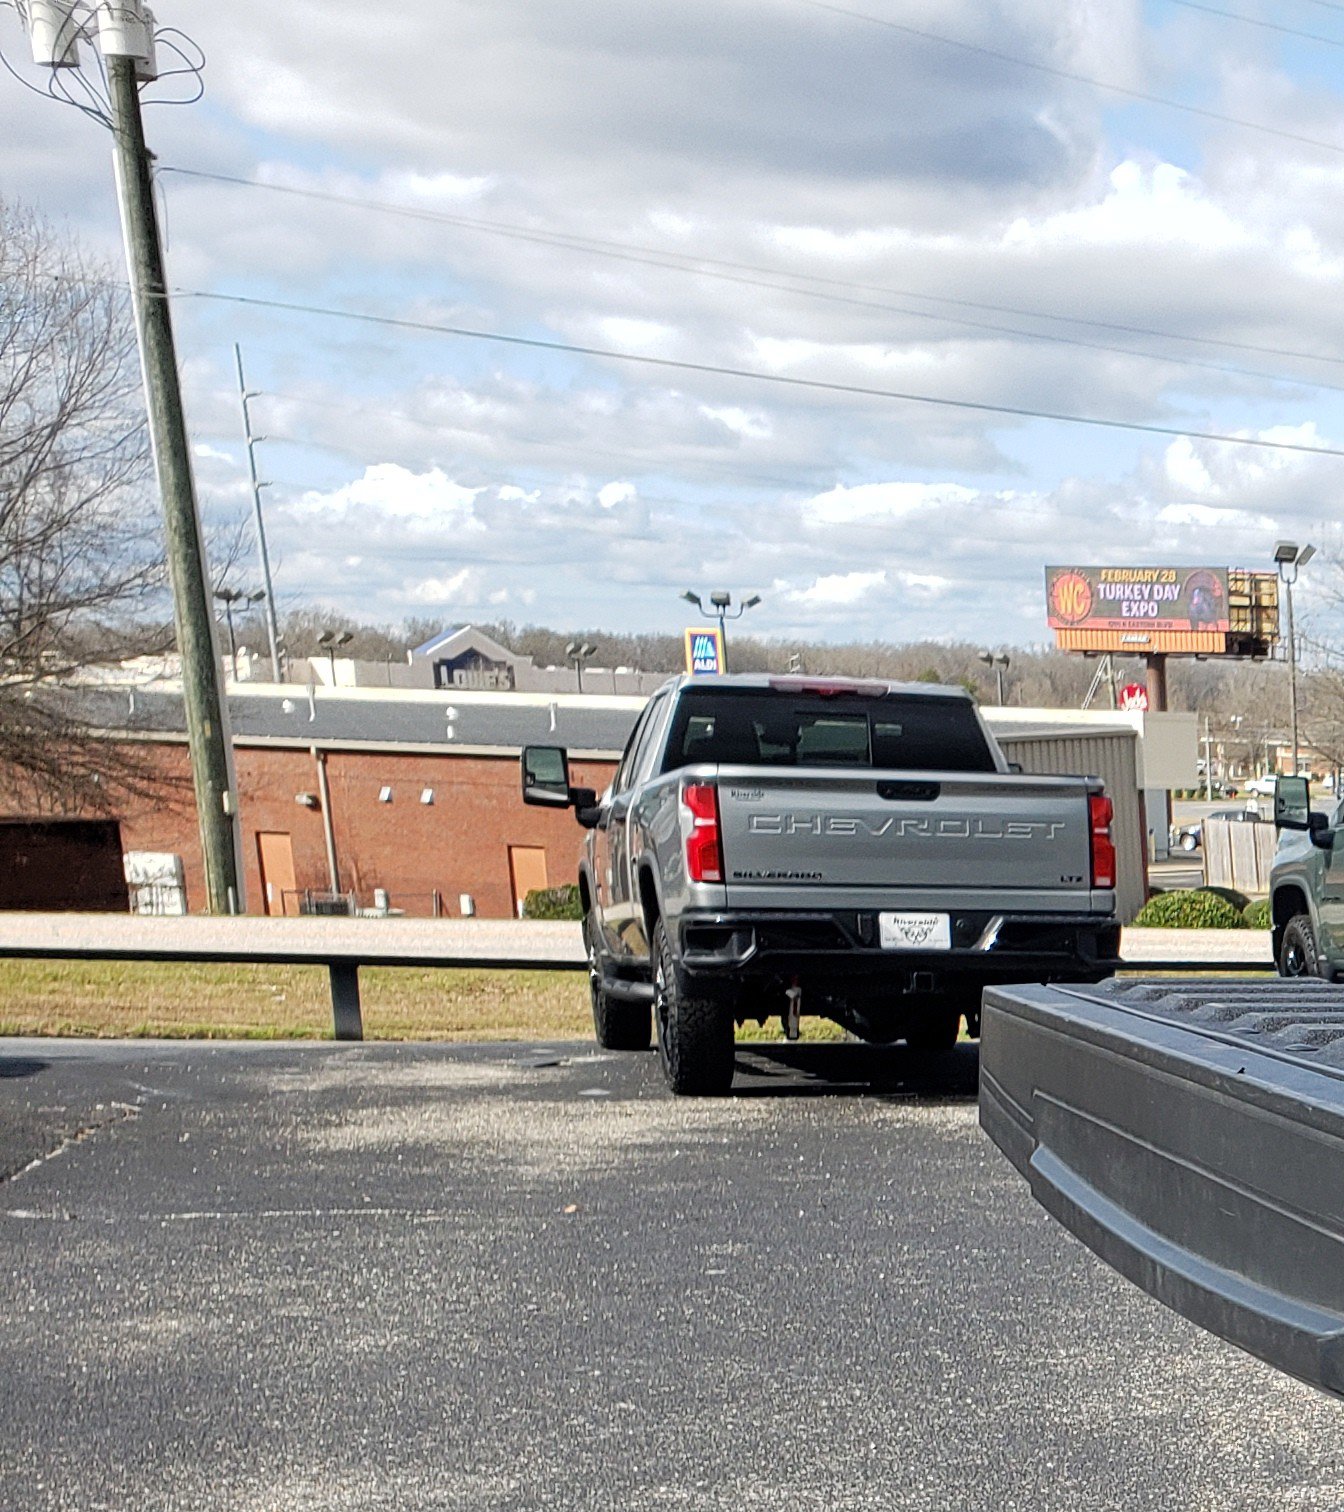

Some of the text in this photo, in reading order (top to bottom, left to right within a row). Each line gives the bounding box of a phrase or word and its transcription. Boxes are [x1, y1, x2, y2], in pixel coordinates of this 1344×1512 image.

[1101, 569, 1159, 582] FEBRUARY
[1058, 580, 1085, 615] WC
[1097, 583, 1180, 600] TURKEY DAY
[1121, 601, 1158, 617] EXPO
[748, 813, 1065, 839] CHEVROLET
